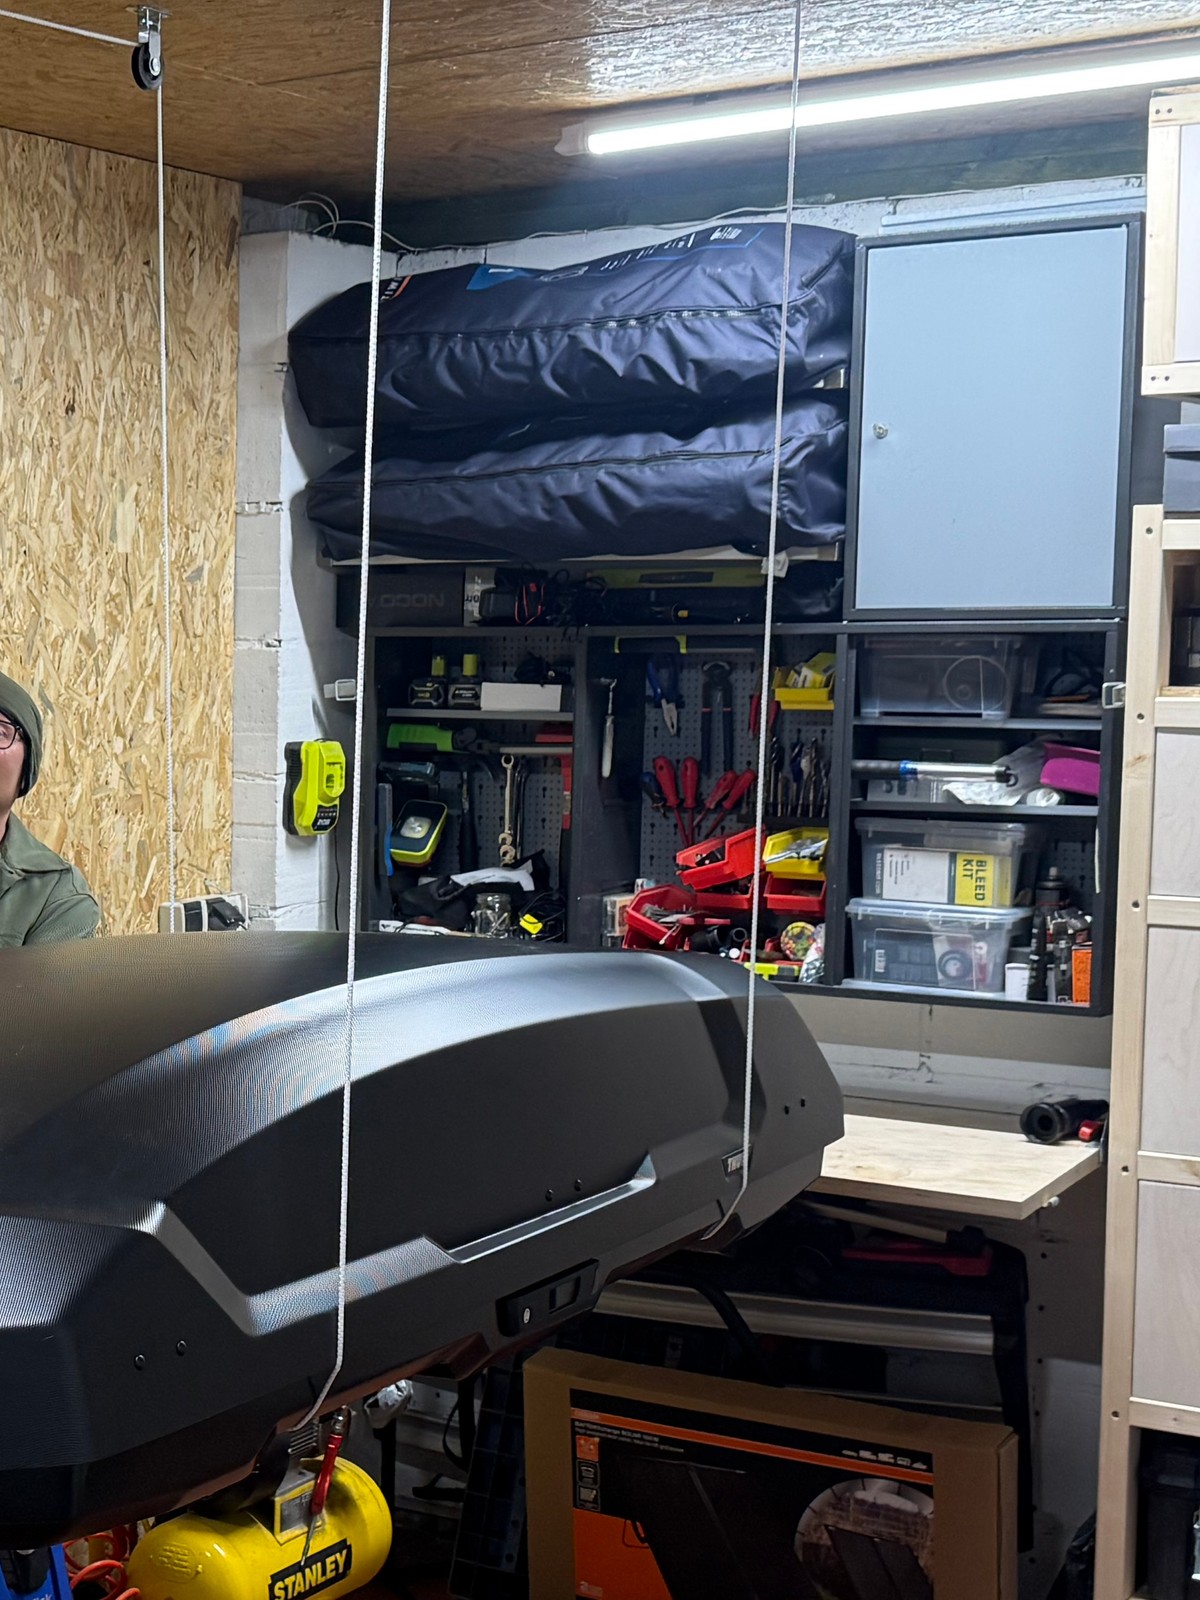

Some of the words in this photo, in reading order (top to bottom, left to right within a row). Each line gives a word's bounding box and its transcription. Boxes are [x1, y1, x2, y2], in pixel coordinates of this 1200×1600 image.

[962, 858, 974, 880] KIT
[974, 859, 987, 901] BLEED
[273, 1548, 348, 1600] STANLEY
